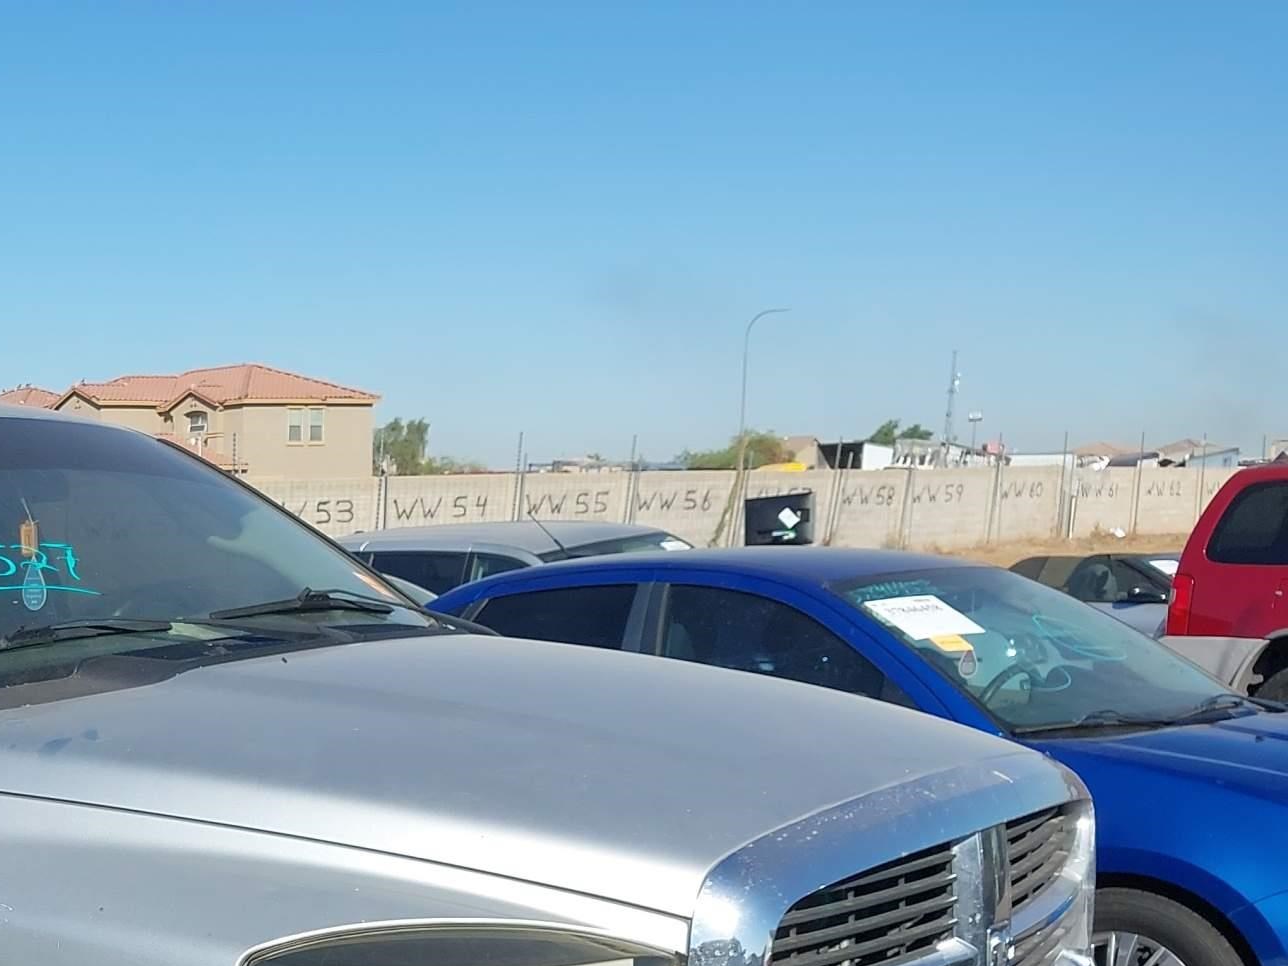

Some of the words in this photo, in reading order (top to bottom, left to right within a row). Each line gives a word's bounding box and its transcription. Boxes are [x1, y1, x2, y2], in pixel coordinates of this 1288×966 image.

[525, 493, 567, 514] WW
[574, 491, 609, 514] 55
[636, 490, 677, 511] WW
[683, 490, 712, 511] 56
[842, 487, 874, 505] WW
[876, 486, 896, 506] 58
[913, 485, 941, 503] WW
[945, 484, 964, 503] 59
[315, 500, 354, 524] 53
[394, 496, 442, 521] WW
[453, 495, 488, 518] 54
